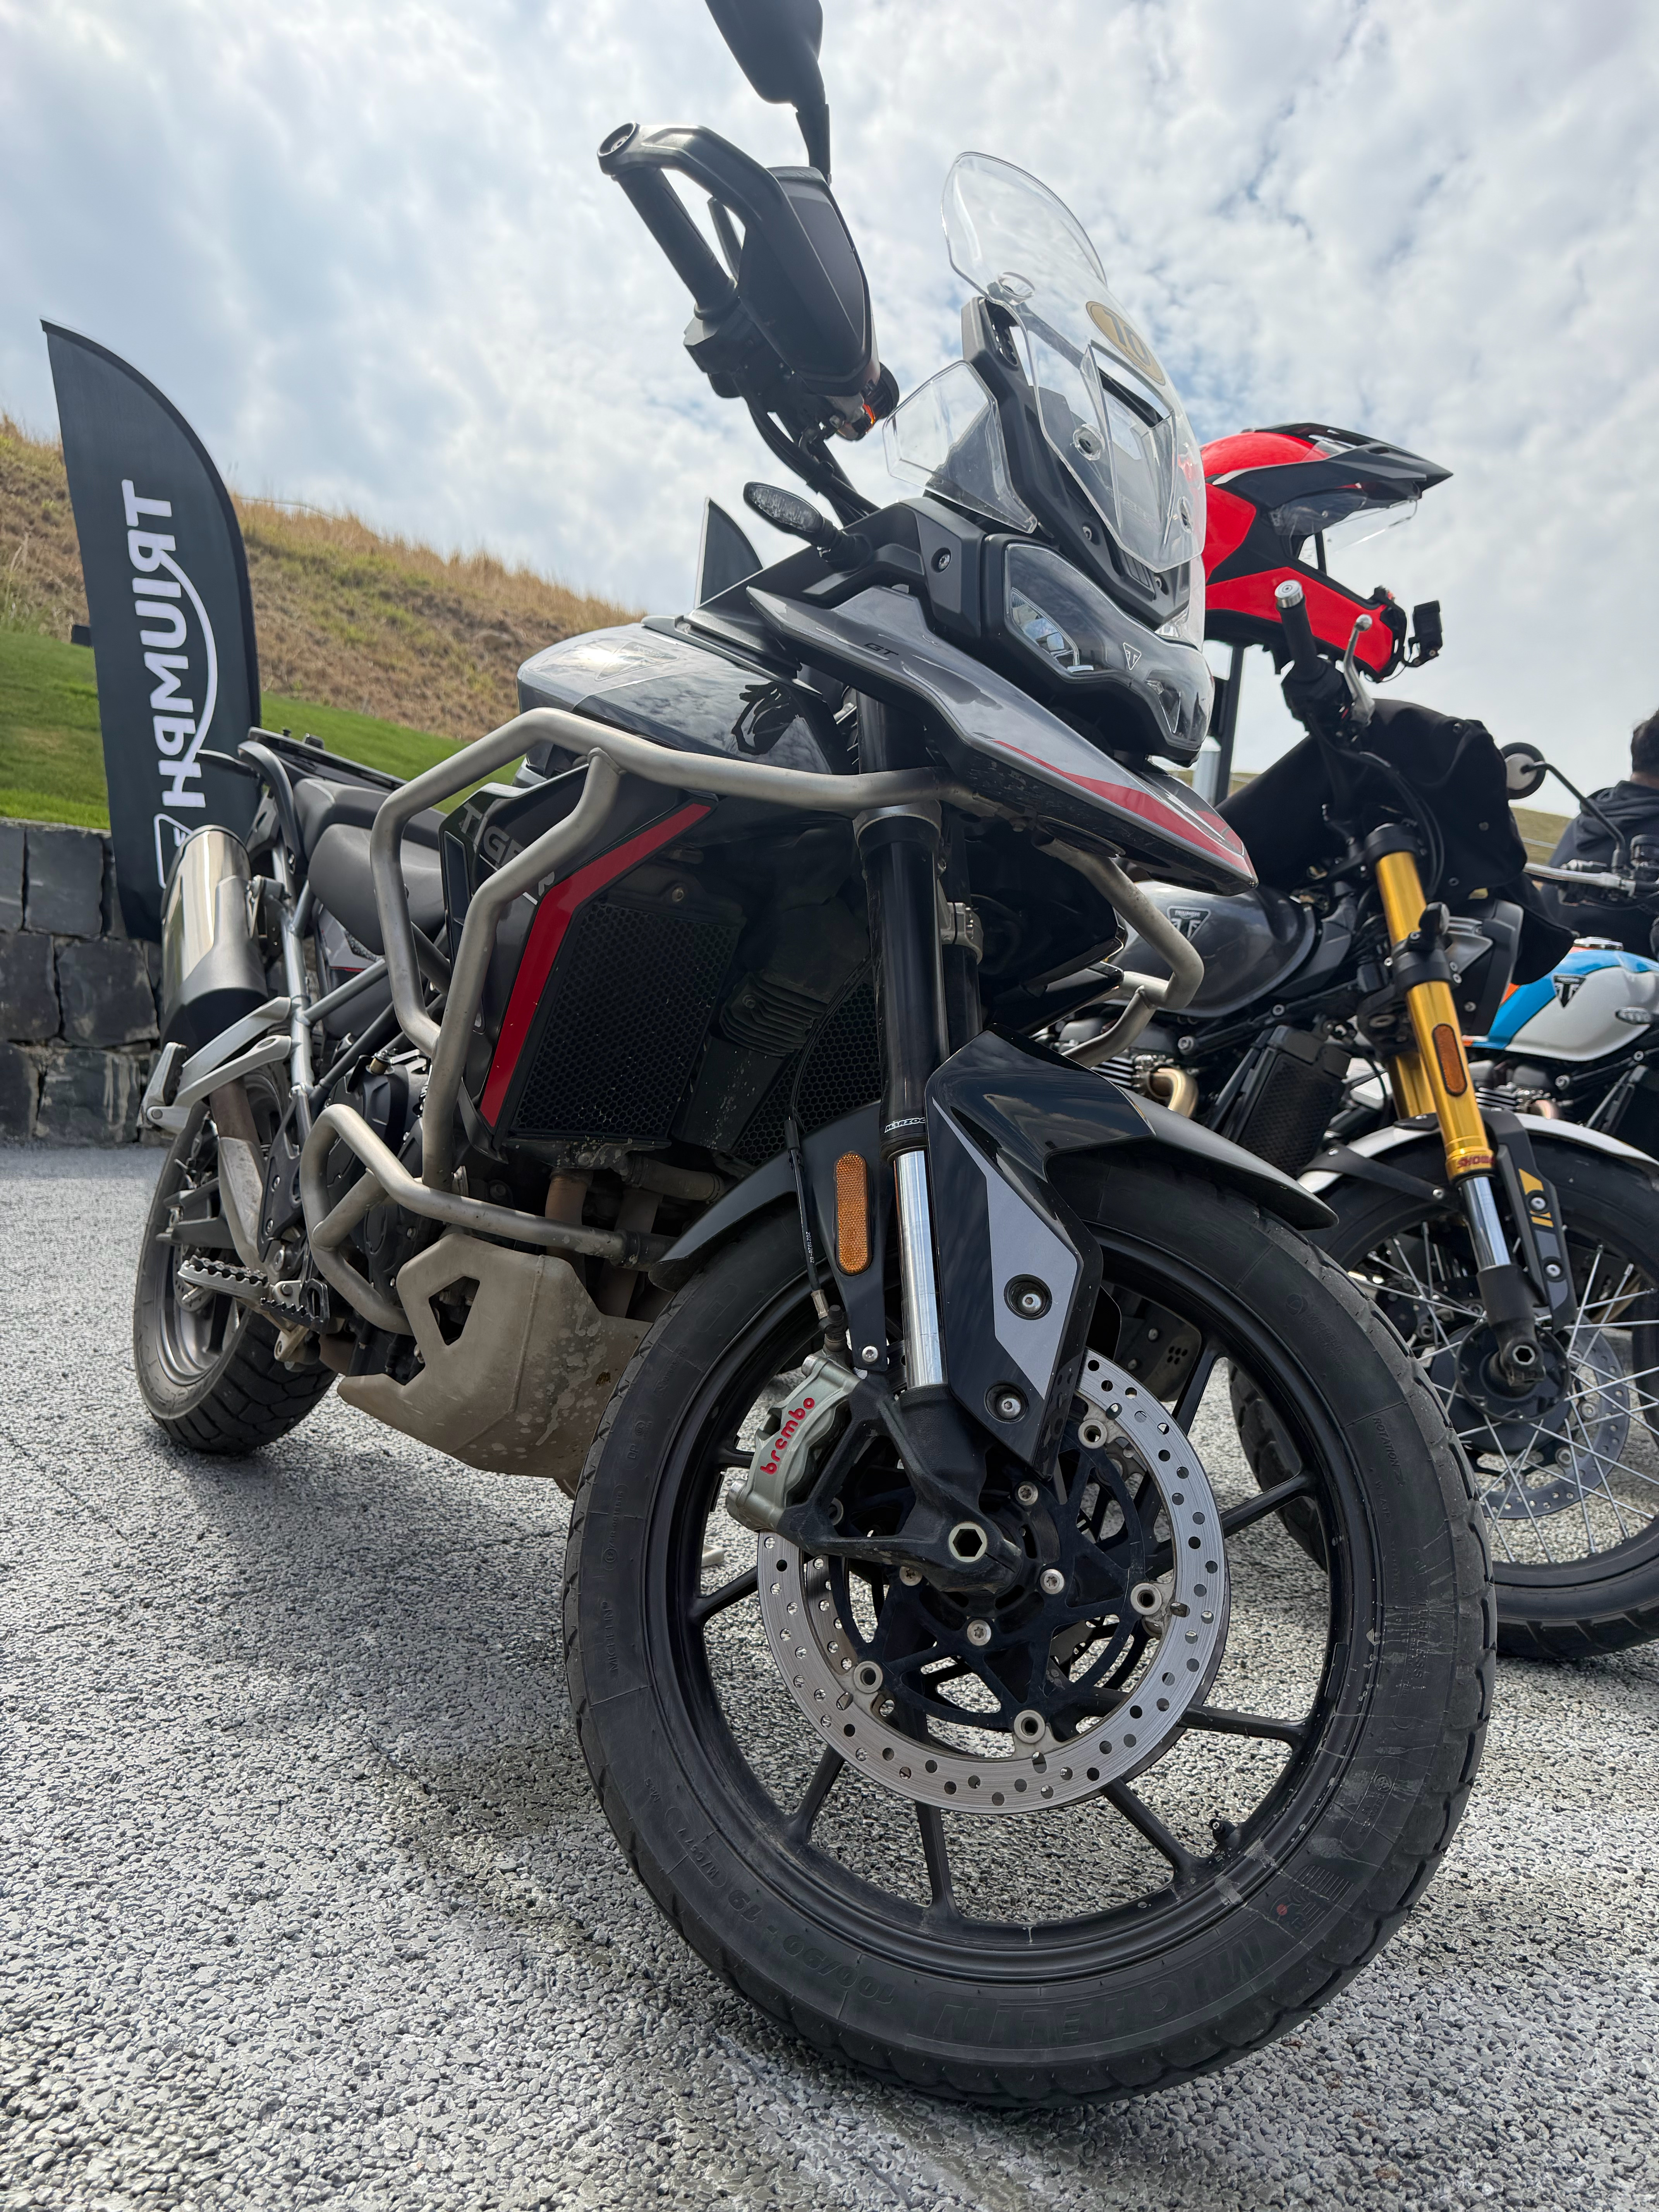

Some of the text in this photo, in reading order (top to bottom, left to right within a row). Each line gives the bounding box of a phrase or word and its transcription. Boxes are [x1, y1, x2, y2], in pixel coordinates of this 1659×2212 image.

[864, 643, 899, 655] GT
[884, 1117, 926, 1133] MARZOC
[1457, 1156, 1494, 1168] SHO
[806, 1231, 814, 1263] 2021928-02
[1306, 1311, 1347, 1357] MICHELIN
[760, 1397, 815, 1475] brembo
[1372, 1417, 1400, 1467] ROTATION
[603, 1608, 618, 1671] MICHELIN
[725, 1887, 763, 1923] 19
[779, 1932, 896, 2005] 100/90
[929, 1928, 1266, 2046] MICHELIN
